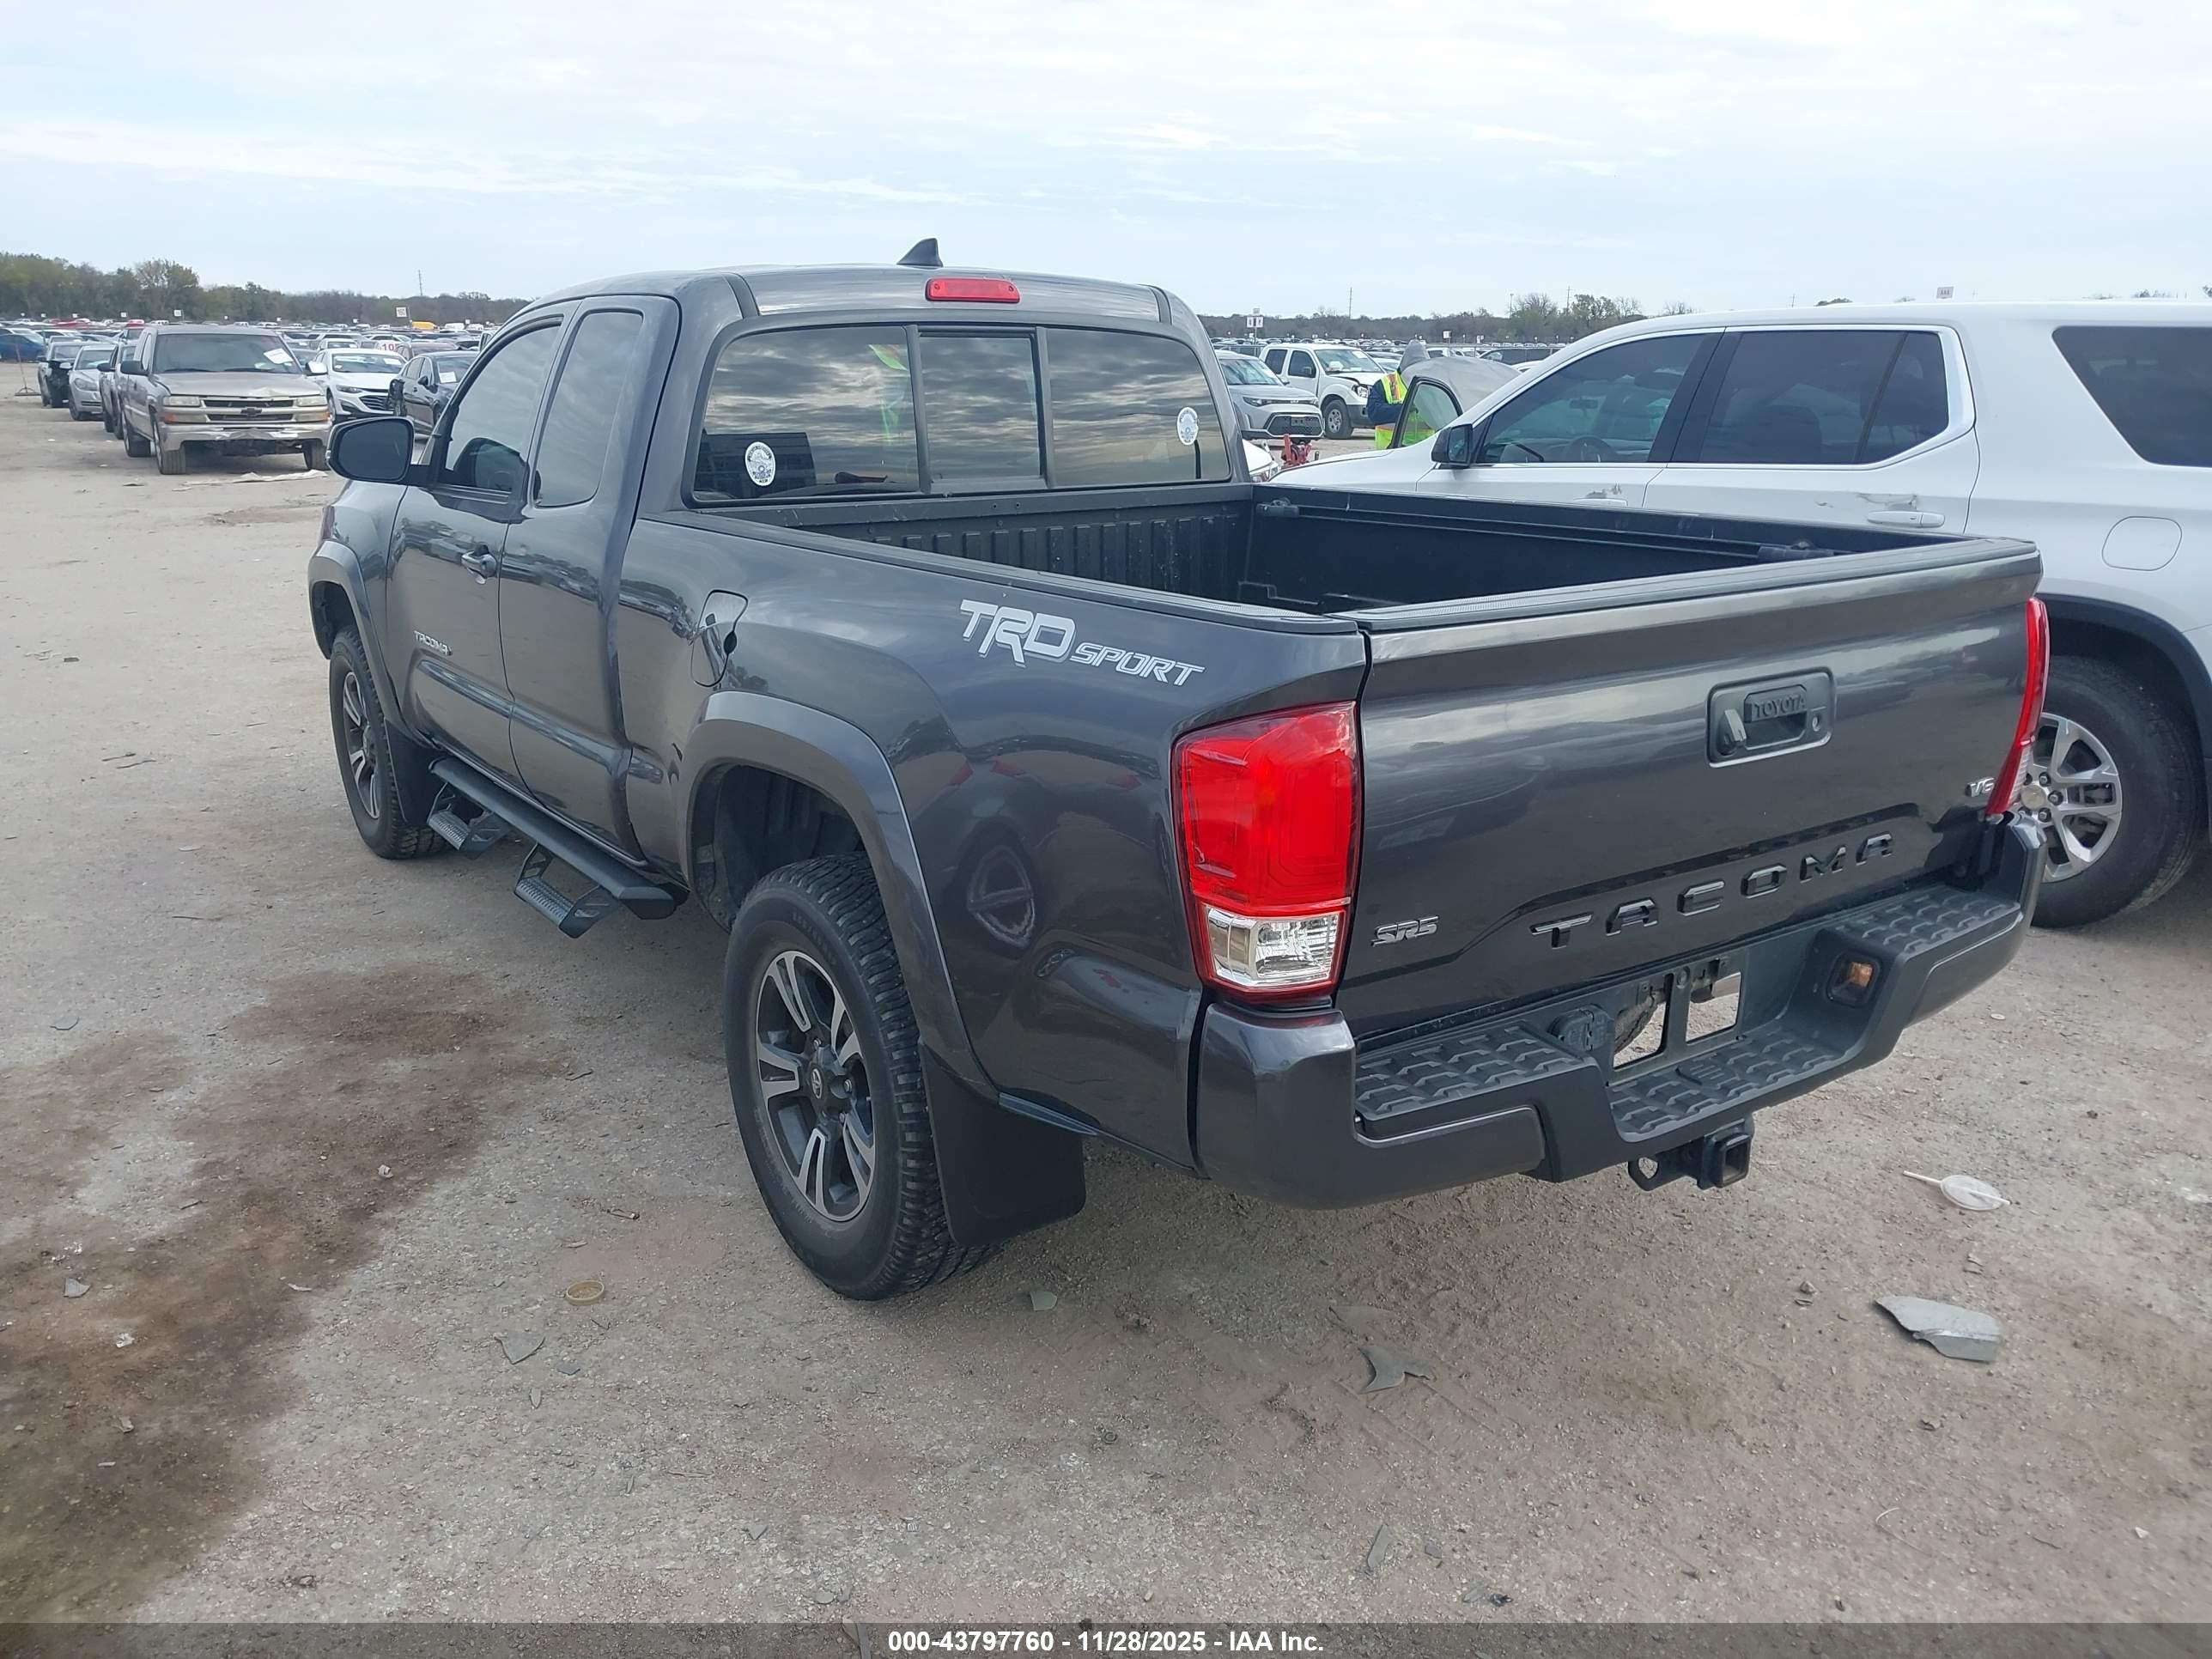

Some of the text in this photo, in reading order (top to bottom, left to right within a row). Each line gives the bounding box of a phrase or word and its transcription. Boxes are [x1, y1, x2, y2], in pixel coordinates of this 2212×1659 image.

[960, 599, 1205, 686] TRD SPORT
[1966, 777, 1995, 797] V6
[1529, 831, 1894, 949] TACOMA
[1370, 915, 1439, 946] SR5
